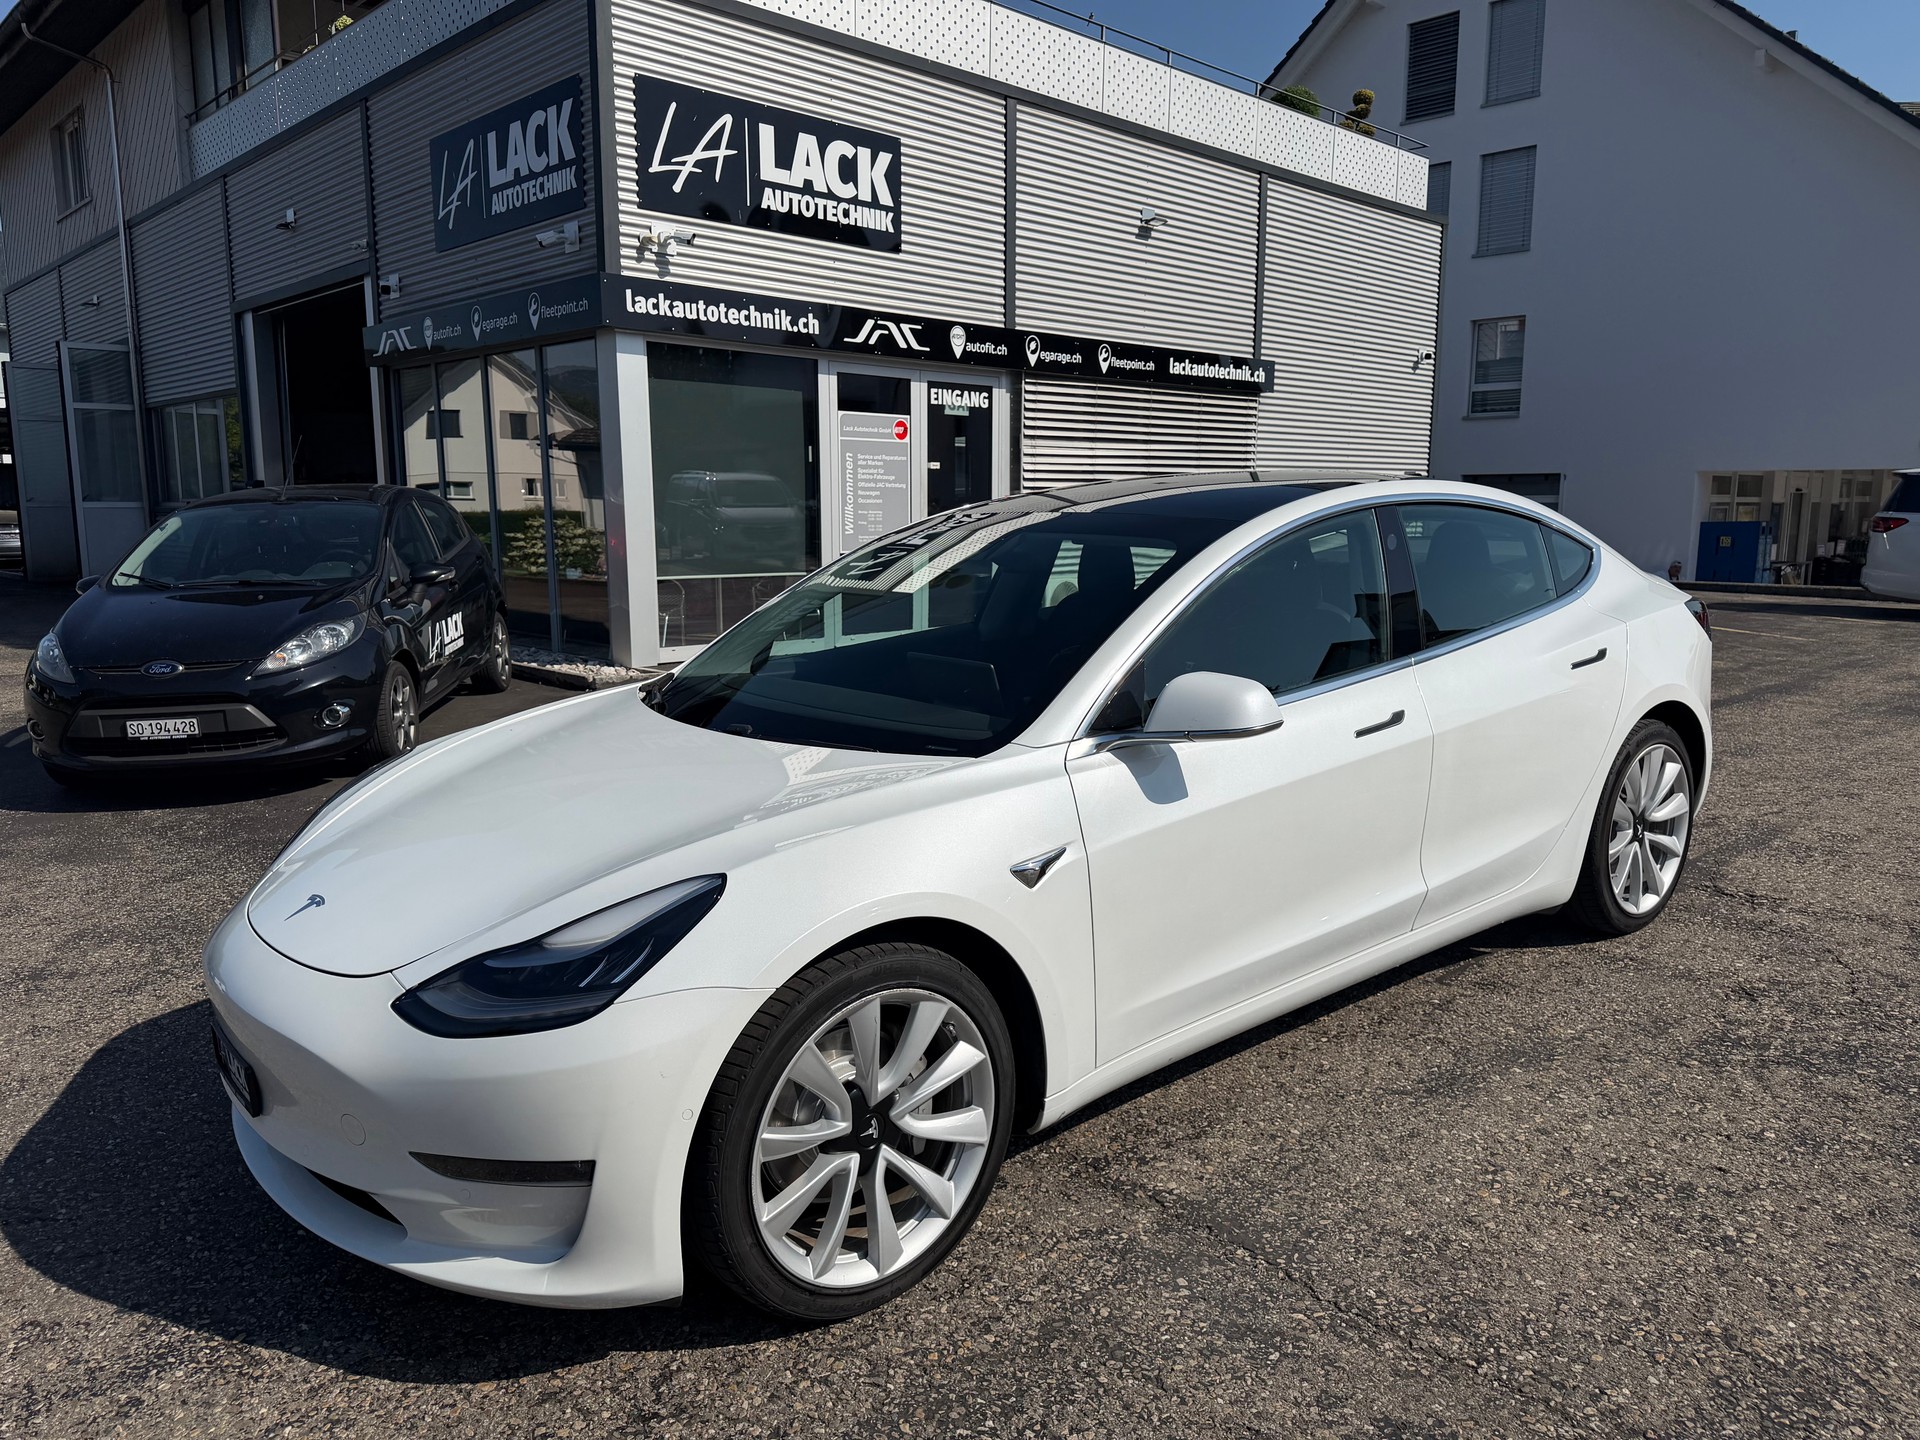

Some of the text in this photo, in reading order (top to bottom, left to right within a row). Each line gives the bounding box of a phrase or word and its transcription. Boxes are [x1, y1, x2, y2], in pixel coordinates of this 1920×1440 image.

[487, 97, 577, 188] LACK
[758, 122, 895, 207] LACK
[491, 165, 577, 216] AUTOTECHNIK
[760, 187, 895, 233] AUTOTECHNIK
[540, 297, 589, 319] fleetpoint.ch
[625, 288, 820, 335] lackautotechnik.ch
[433, 326, 462, 341] autofit.ch
[482, 312, 518, 332] egarage.ch
[965, 341, 1008, 356] autofit.ch
[1039, 350, 1082, 365] egarage.ch
[1110, 356, 1155, 372] fleetpoint.ch
[1169, 357, 1266, 383] lackautotechnik.ch
[930, 388, 989, 409] EINGANG
[844, 452, 854, 535] Willkommen
[442, 611, 464, 645] LACK
[149, 663, 172, 674] Ford
